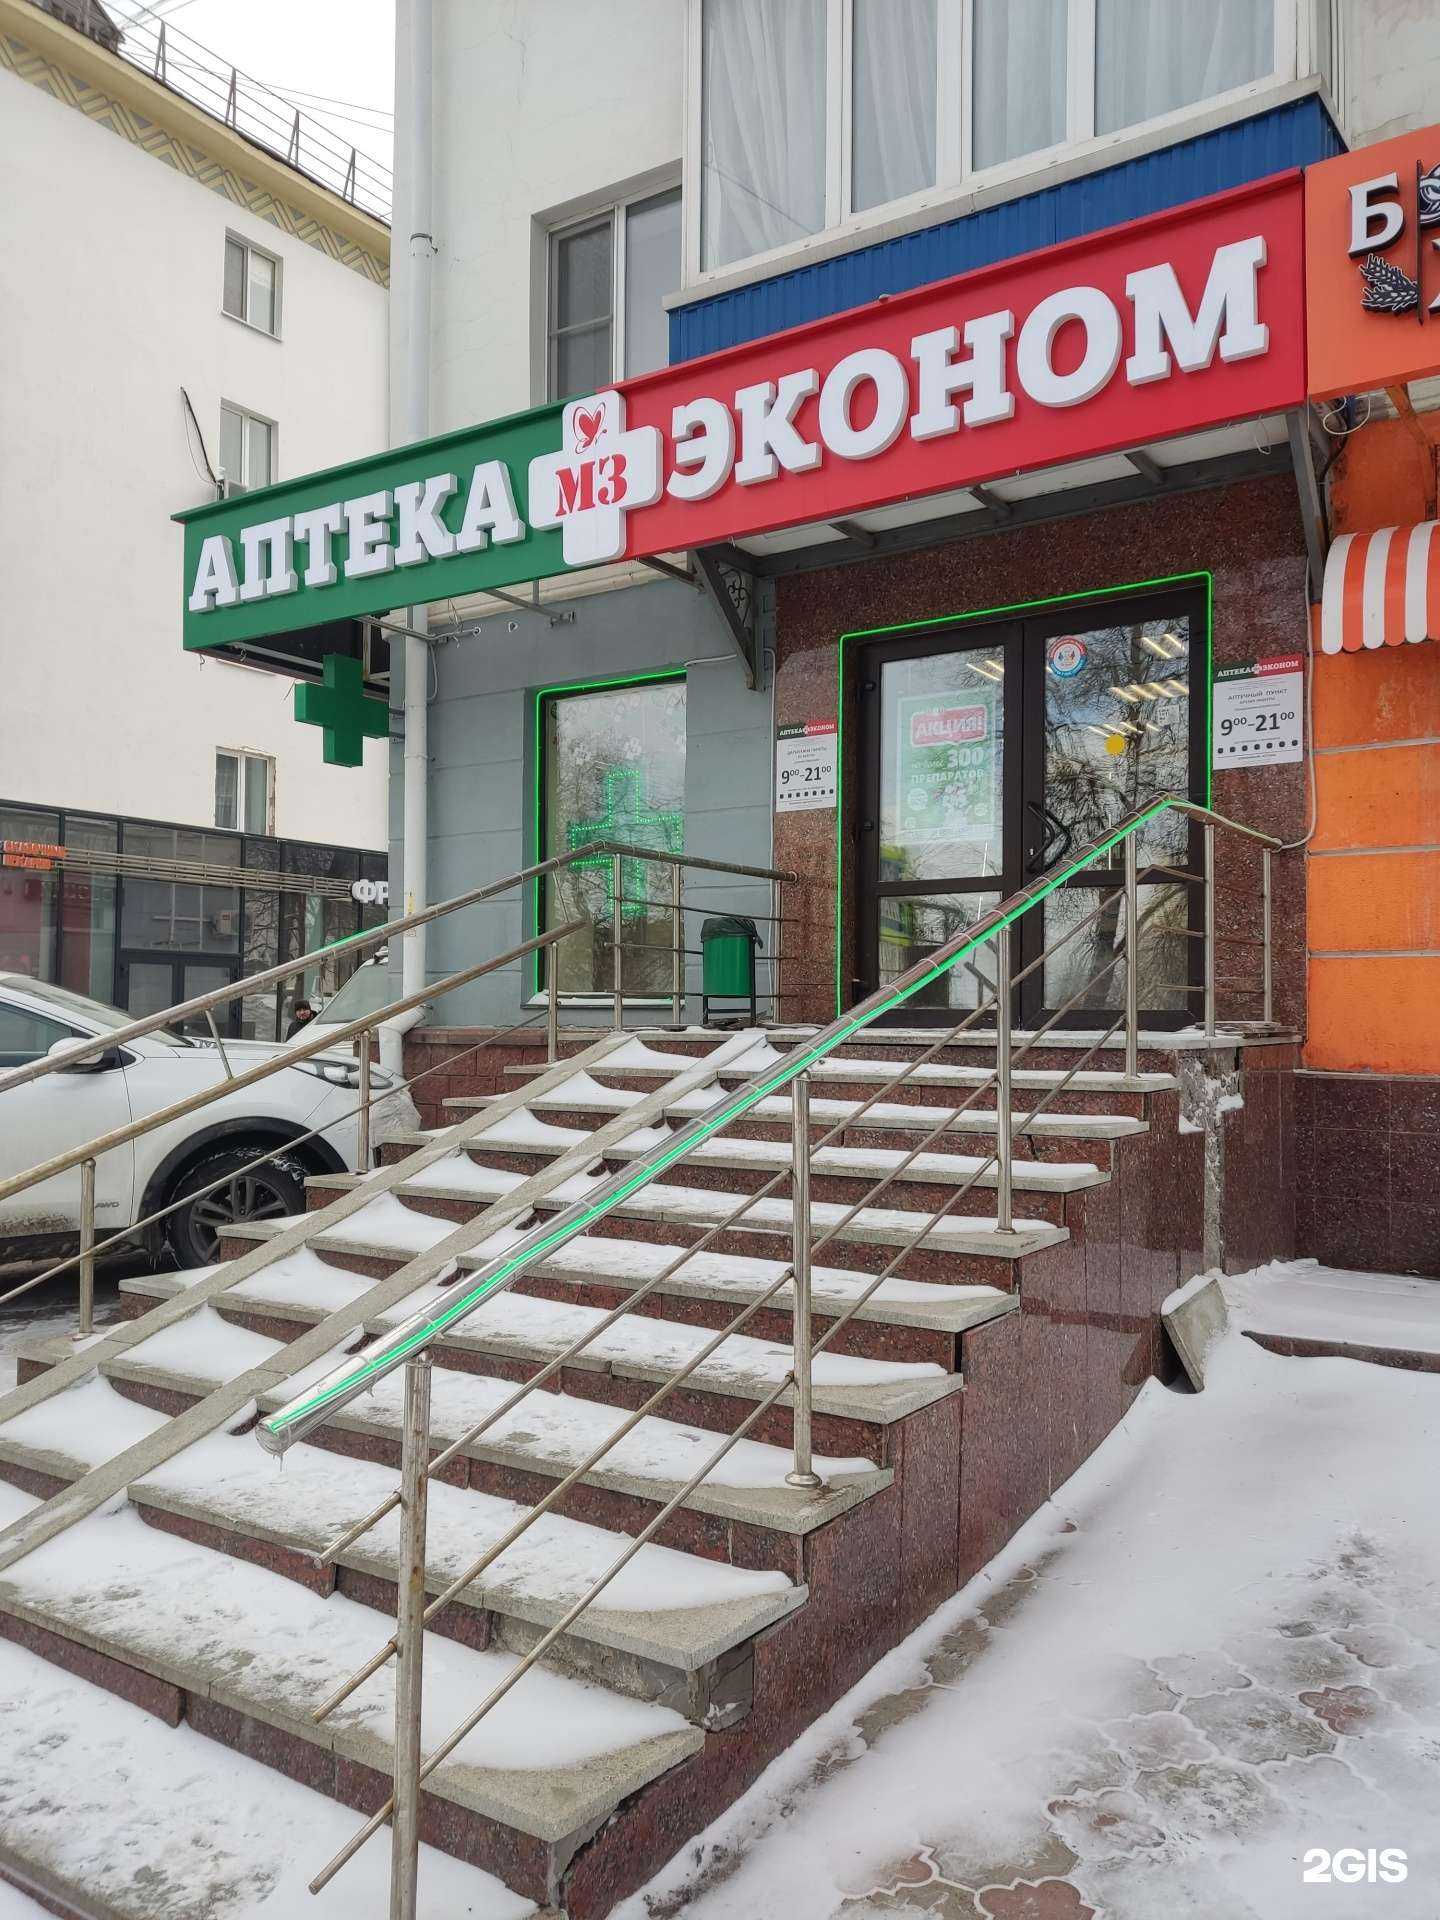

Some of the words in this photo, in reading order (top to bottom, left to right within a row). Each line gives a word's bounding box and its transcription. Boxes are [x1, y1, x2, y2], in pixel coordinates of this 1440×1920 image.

[189, 459, 526, 613] АПТЕКА
[666, 234, 1270, 502] ЭКОНОМ
[1217, 667, 1251, 677] АПТЕКА
[1262, 660, 1299, 671] ЭКОНОМ
[947, 747, 984, 769] 300
[911, 768, 985, 784] ПРЕПАРАТОВ
